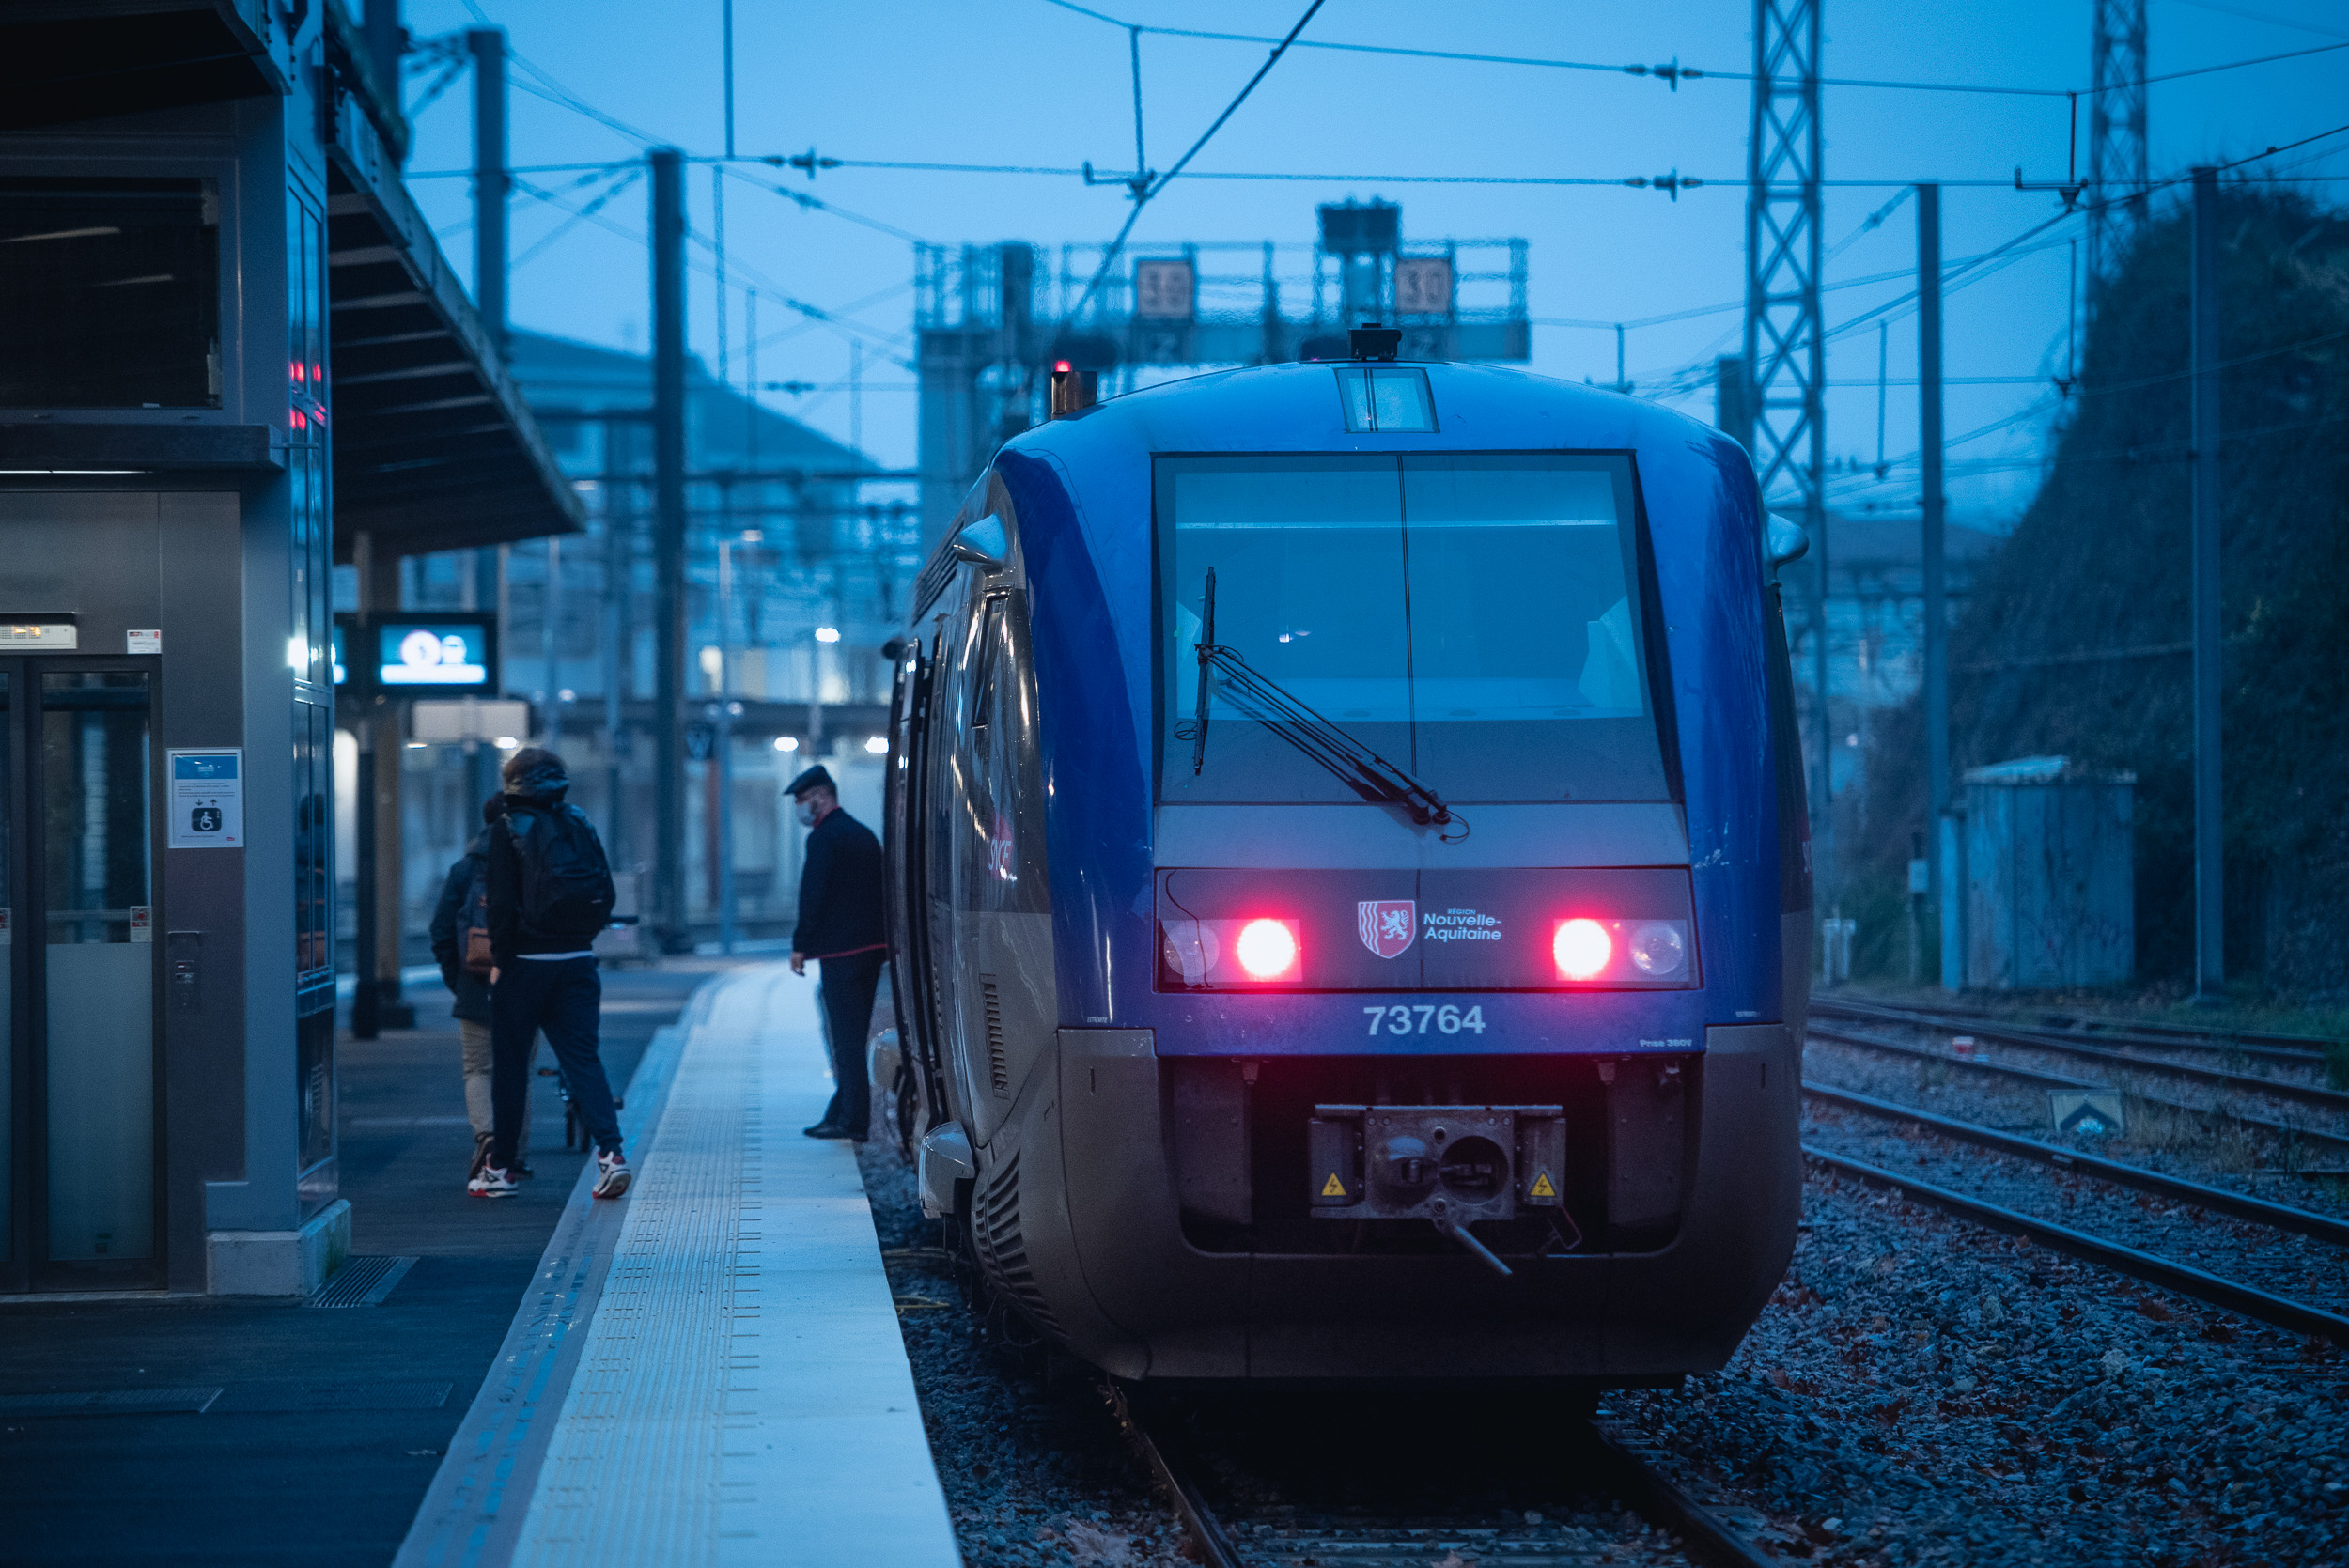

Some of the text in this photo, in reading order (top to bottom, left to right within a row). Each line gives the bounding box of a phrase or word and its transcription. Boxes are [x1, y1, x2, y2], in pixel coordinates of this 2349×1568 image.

[988, 839, 1012, 871] SNCF
[1423, 913, 1502, 927] Nouvelle-
[1424, 926, 1501, 943] Aquitaine
[1363, 1004, 1486, 1035] 73764
